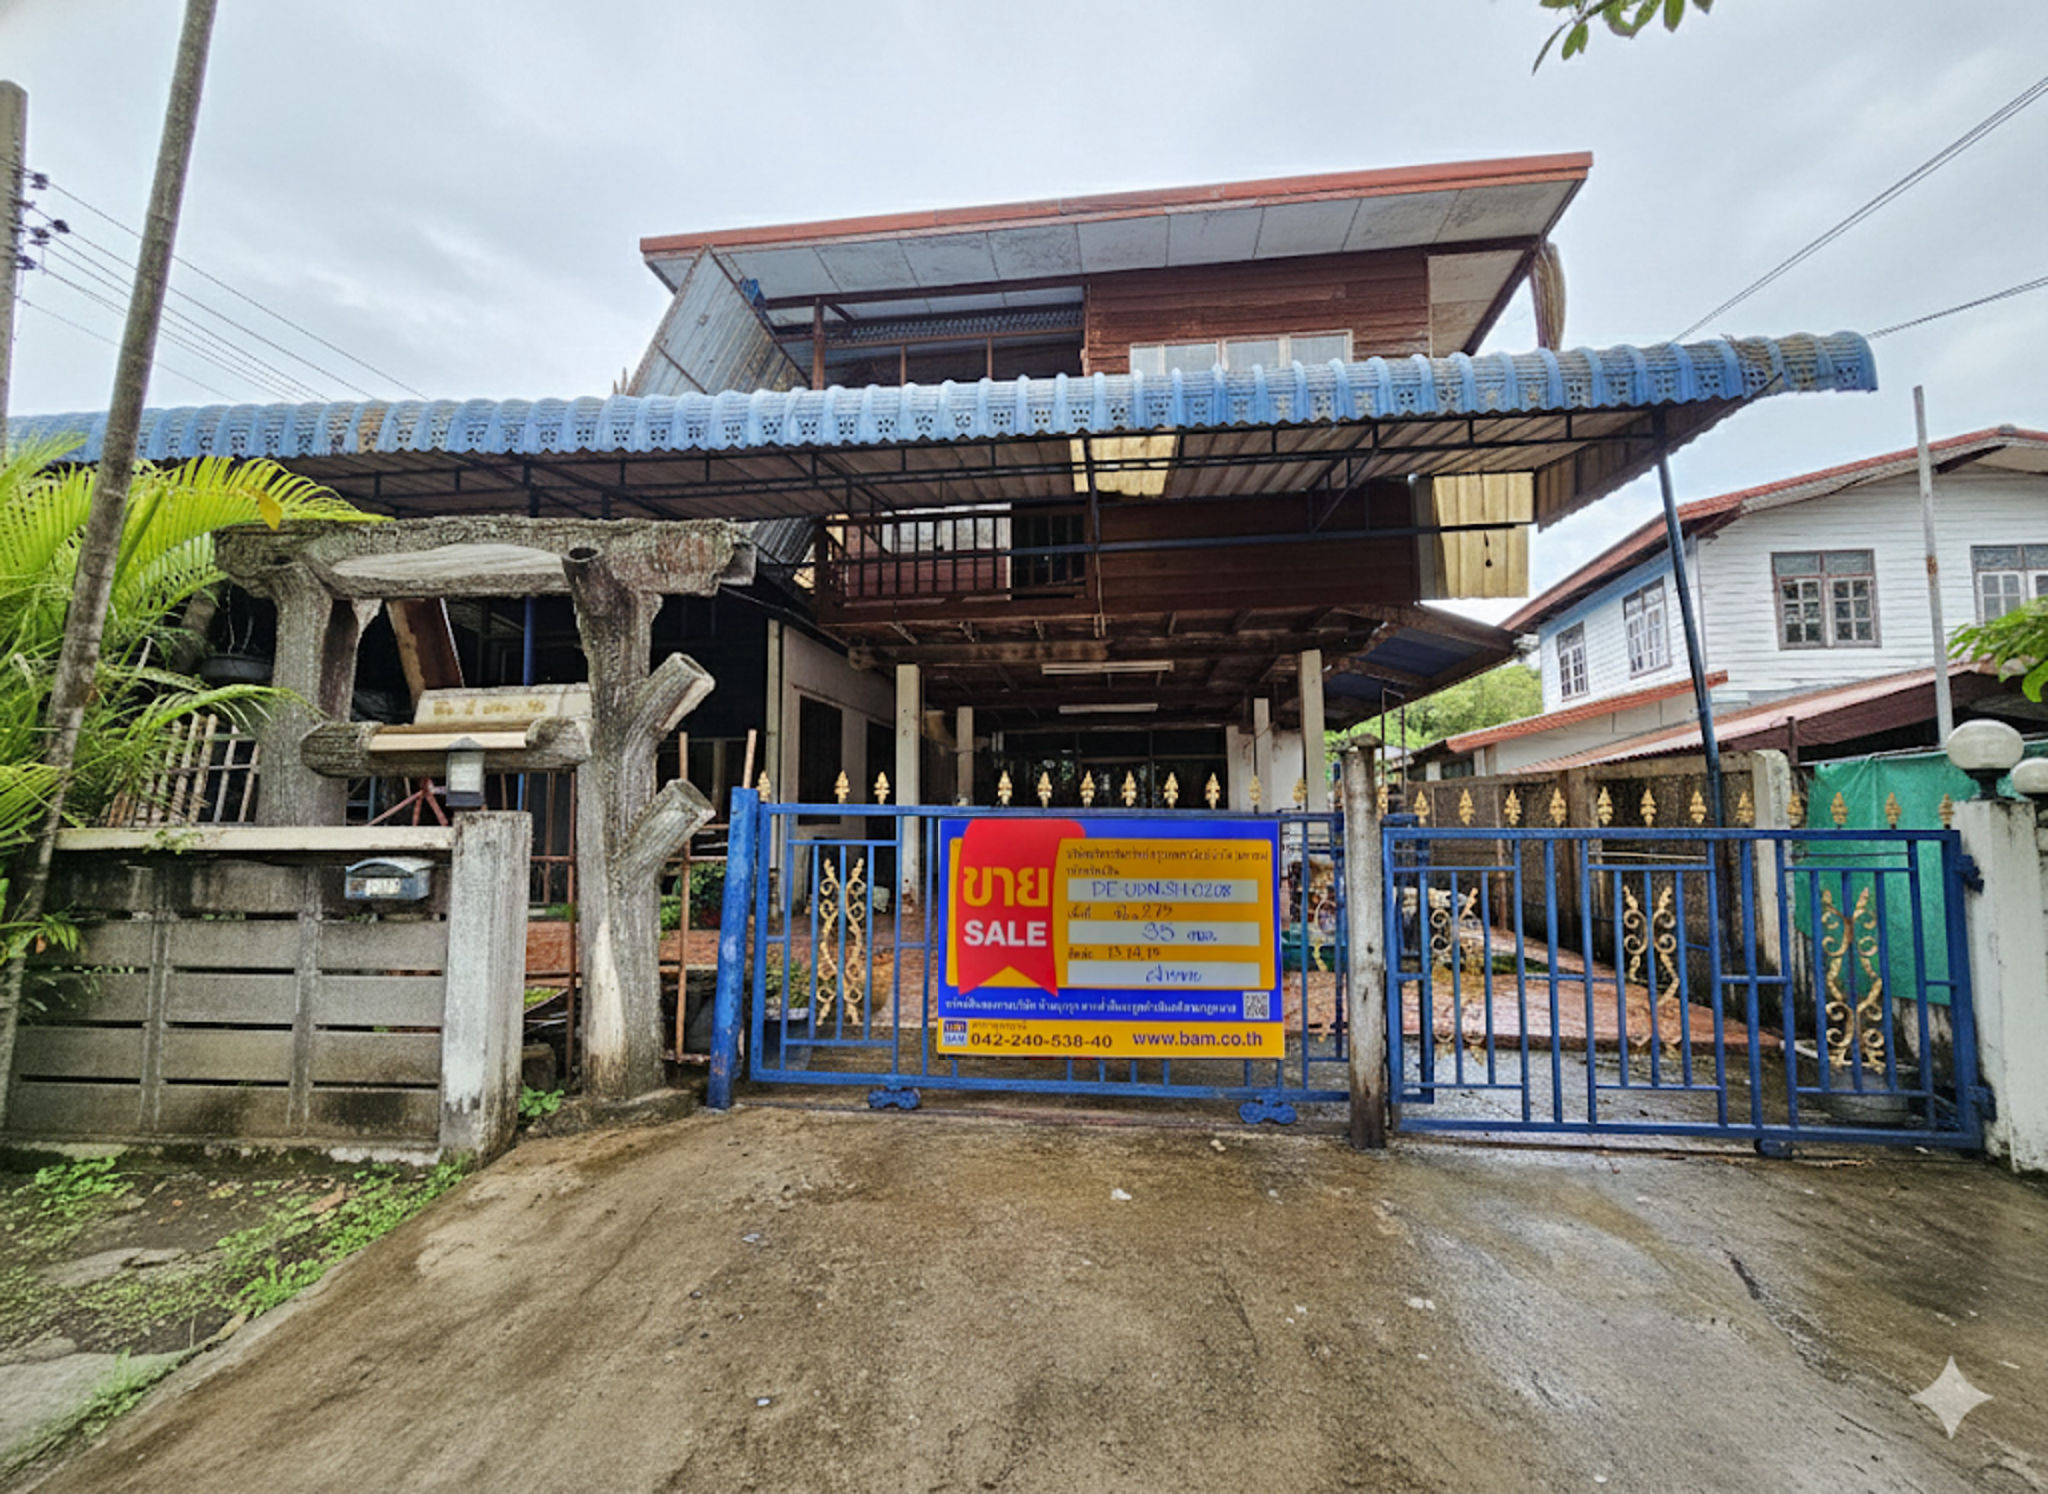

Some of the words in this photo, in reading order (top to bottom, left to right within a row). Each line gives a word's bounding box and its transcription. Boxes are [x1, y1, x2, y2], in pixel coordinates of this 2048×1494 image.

[963, 866, 1050, 908] ขาย
[963, 919, 1047, 948] SALE
[971, 1032, 1113, 1048] 042-240-538-40
[1132, 1030, 1263, 1047] www.bam.co.th
